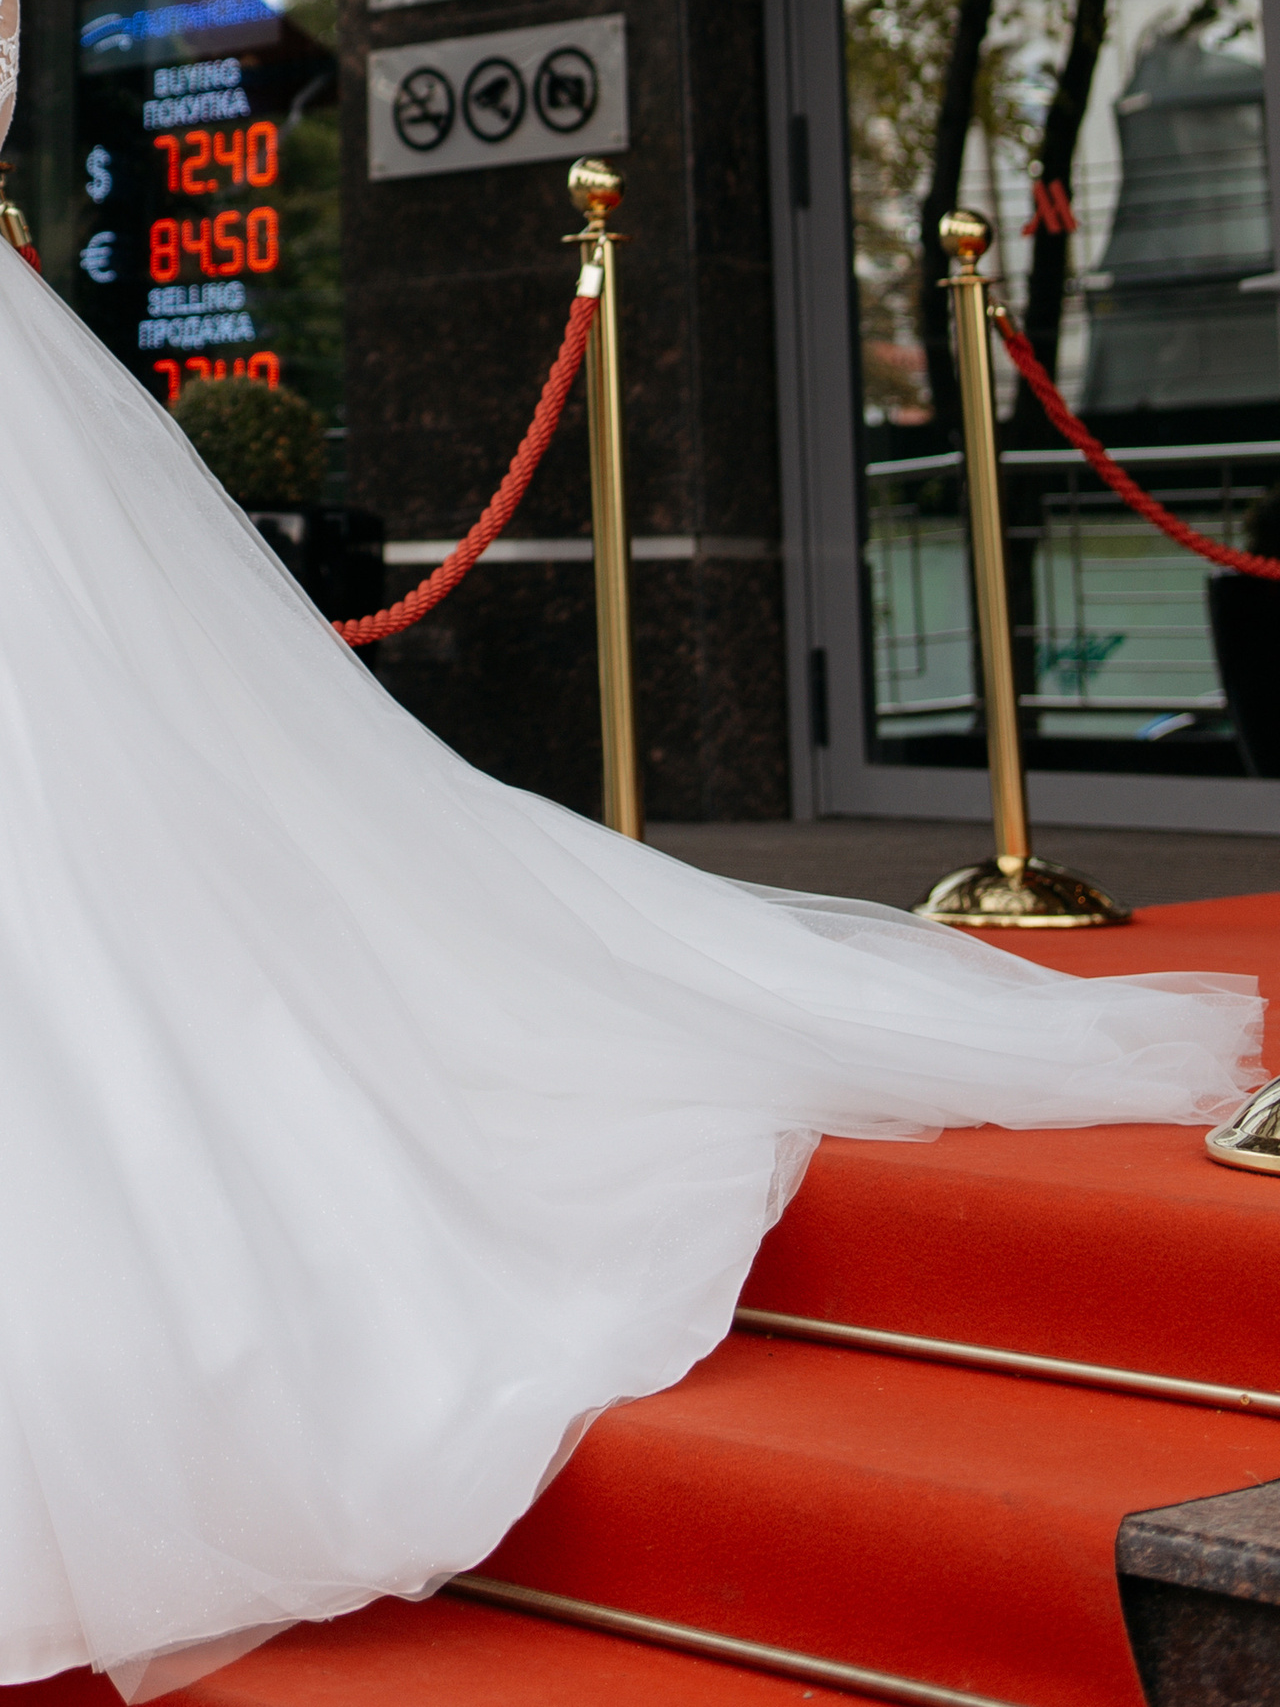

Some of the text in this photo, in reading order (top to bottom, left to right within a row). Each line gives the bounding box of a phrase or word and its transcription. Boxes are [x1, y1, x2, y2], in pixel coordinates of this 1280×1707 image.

[154, 58, 242, 98] BUYING
[144, 87, 251, 130] ПОКУПКА
[86, 145, 113, 204] $
[81, 231, 117, 283] €
[148, 280, 246, 317] SELLING
[138, 312, 256, 350] ПРОДАЖА
